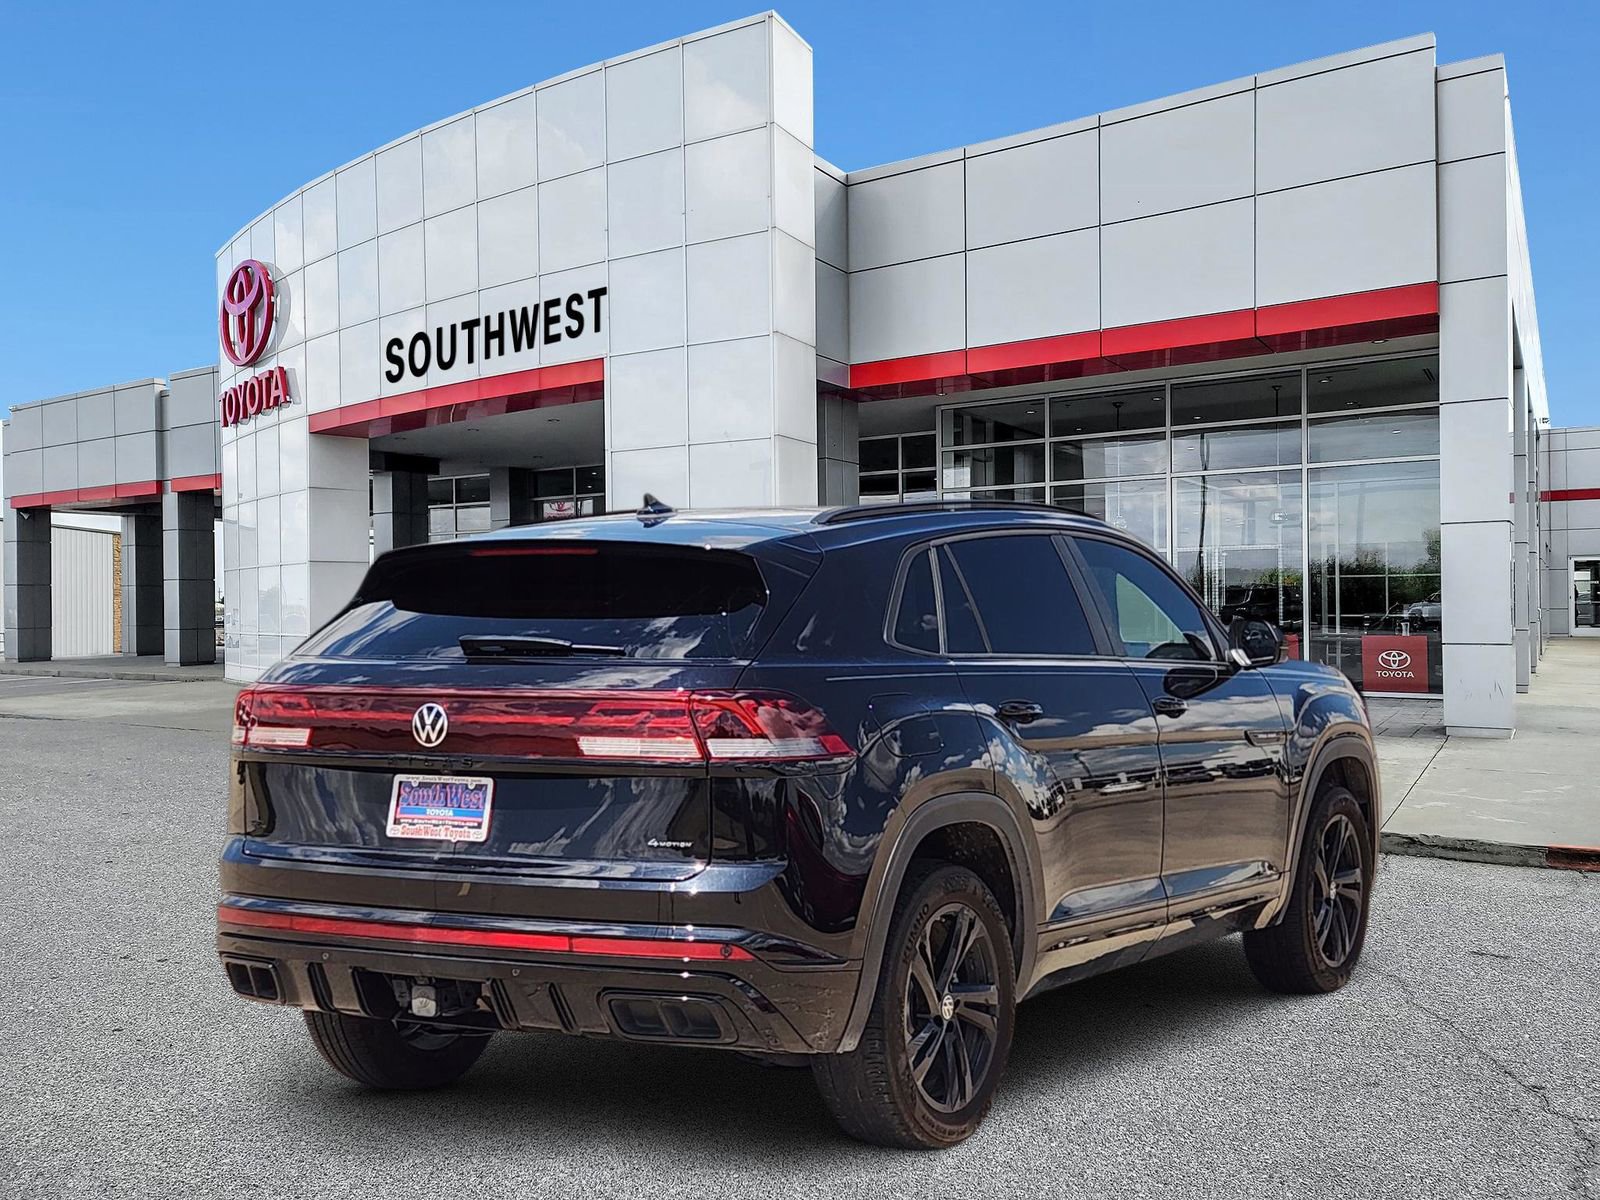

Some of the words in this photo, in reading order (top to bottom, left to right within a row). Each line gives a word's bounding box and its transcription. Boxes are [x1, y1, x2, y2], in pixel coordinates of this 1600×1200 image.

[385, 286, 608, 384] SOUTHWEST
[218, 366, 289, 428] TOYOTA
[1376, 670, 1415, 678] TOYOTA
[426, 808, 454, 816] TOYOTA
